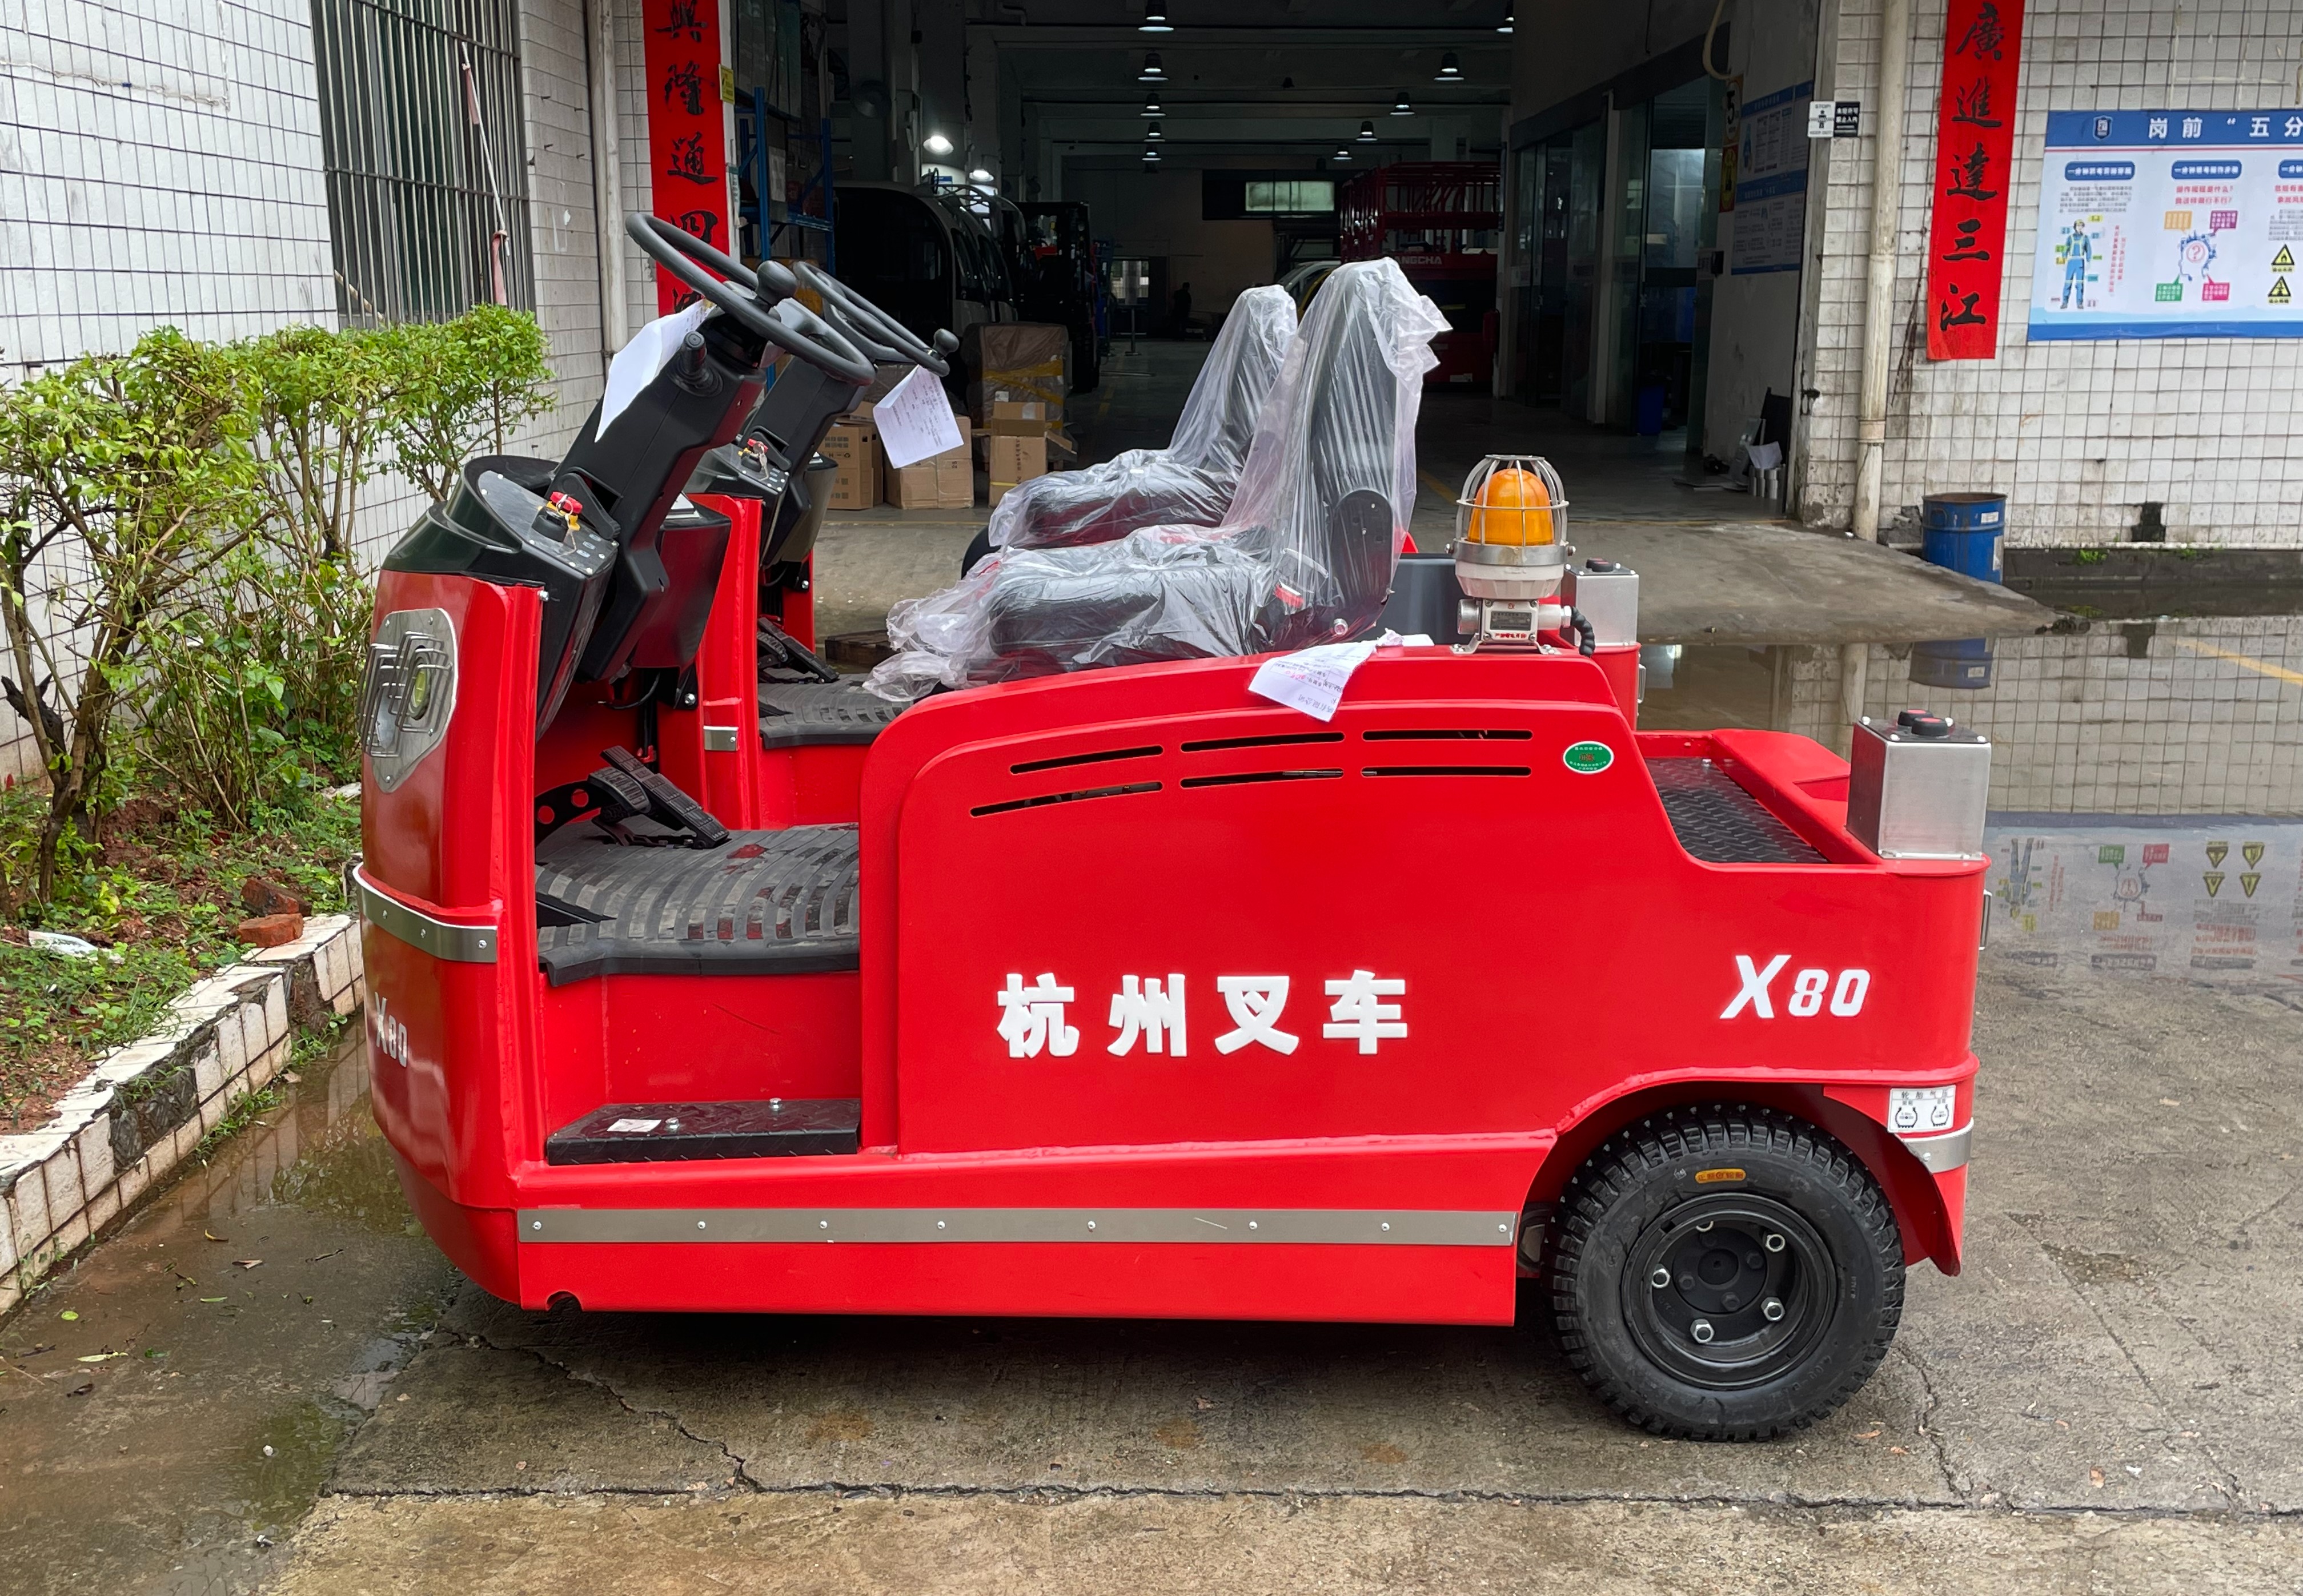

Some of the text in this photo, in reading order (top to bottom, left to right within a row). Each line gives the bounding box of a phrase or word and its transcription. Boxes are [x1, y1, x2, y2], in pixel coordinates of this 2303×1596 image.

[1941, 2, 2005, 331] 廣進達三江
[997, 969, 1408, 1059] 杭州叉车
[1719, 954, 1871, 1019] X80
[375, 991, 408, 1068] X80
